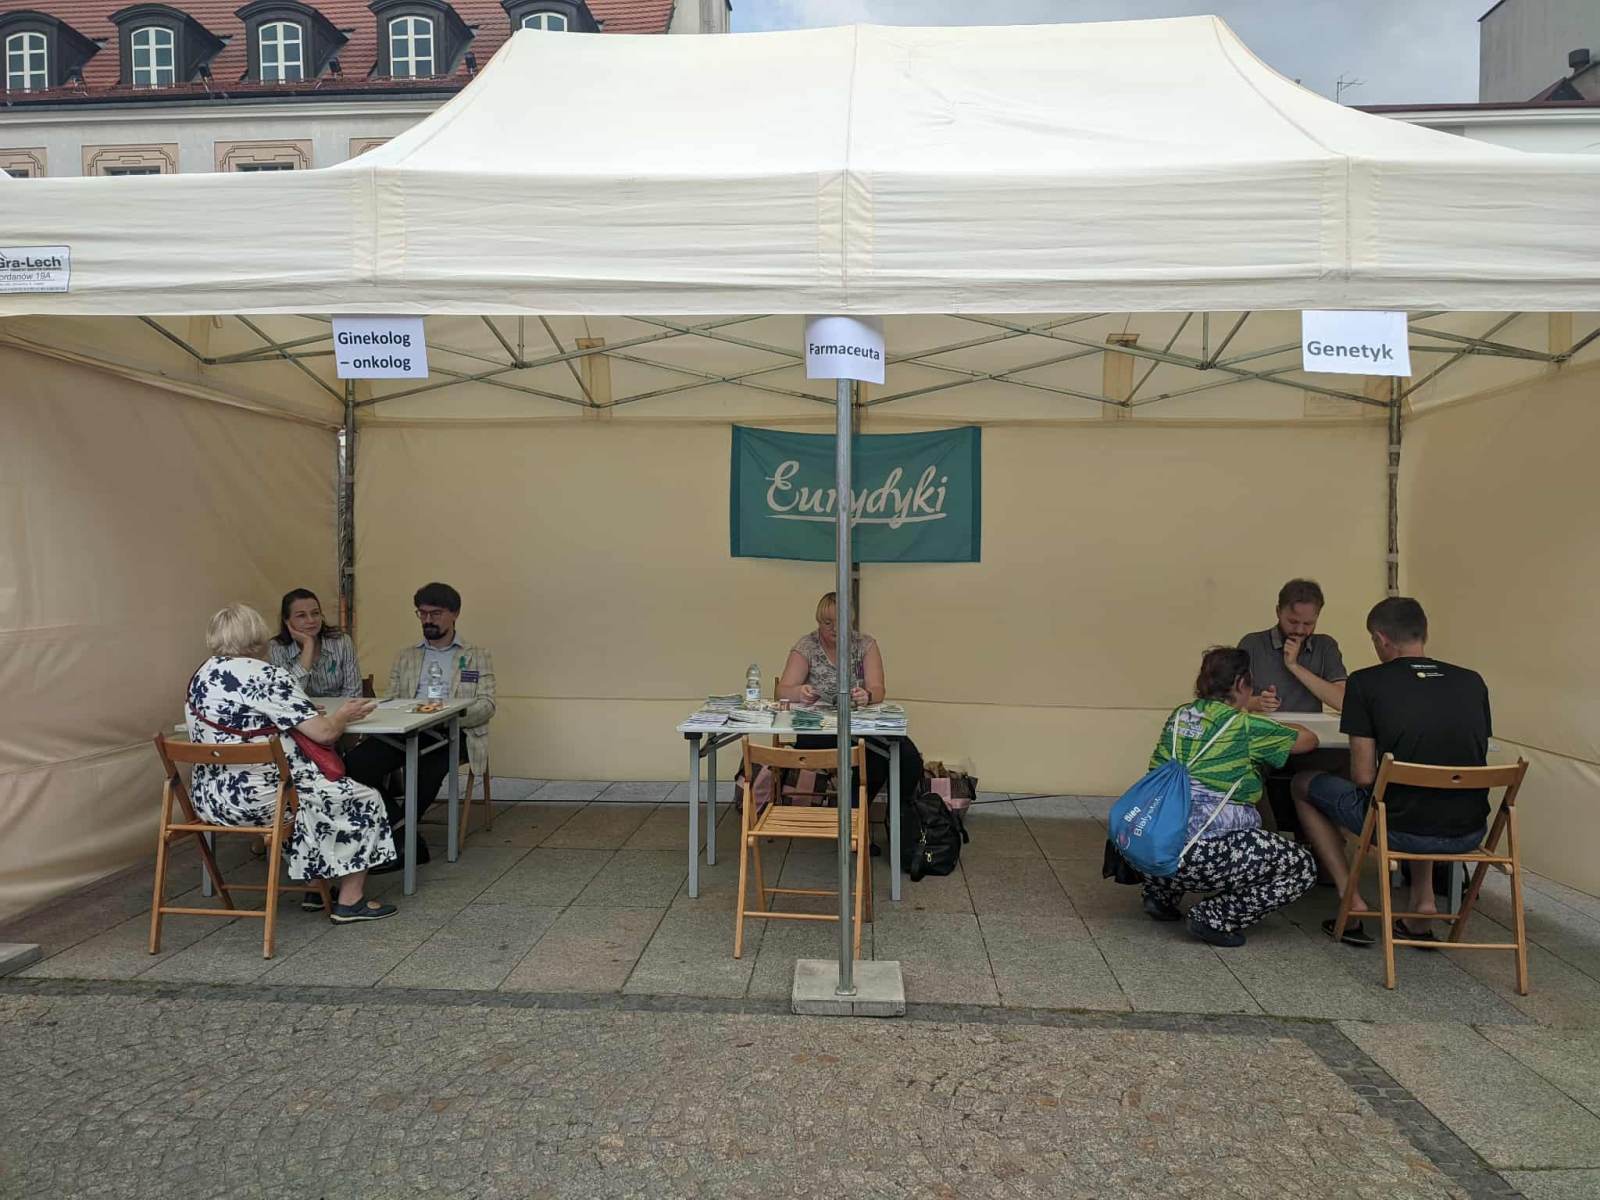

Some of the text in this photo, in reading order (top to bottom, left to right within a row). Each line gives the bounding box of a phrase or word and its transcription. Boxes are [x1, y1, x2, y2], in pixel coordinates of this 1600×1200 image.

[338, 331, 411, 347] Ginekolog
[809, 343, 880, 360] Farmaceuta
[1307, 340, 1394, 362] Genetyk
[353, 355, 411, 371] onkolog
